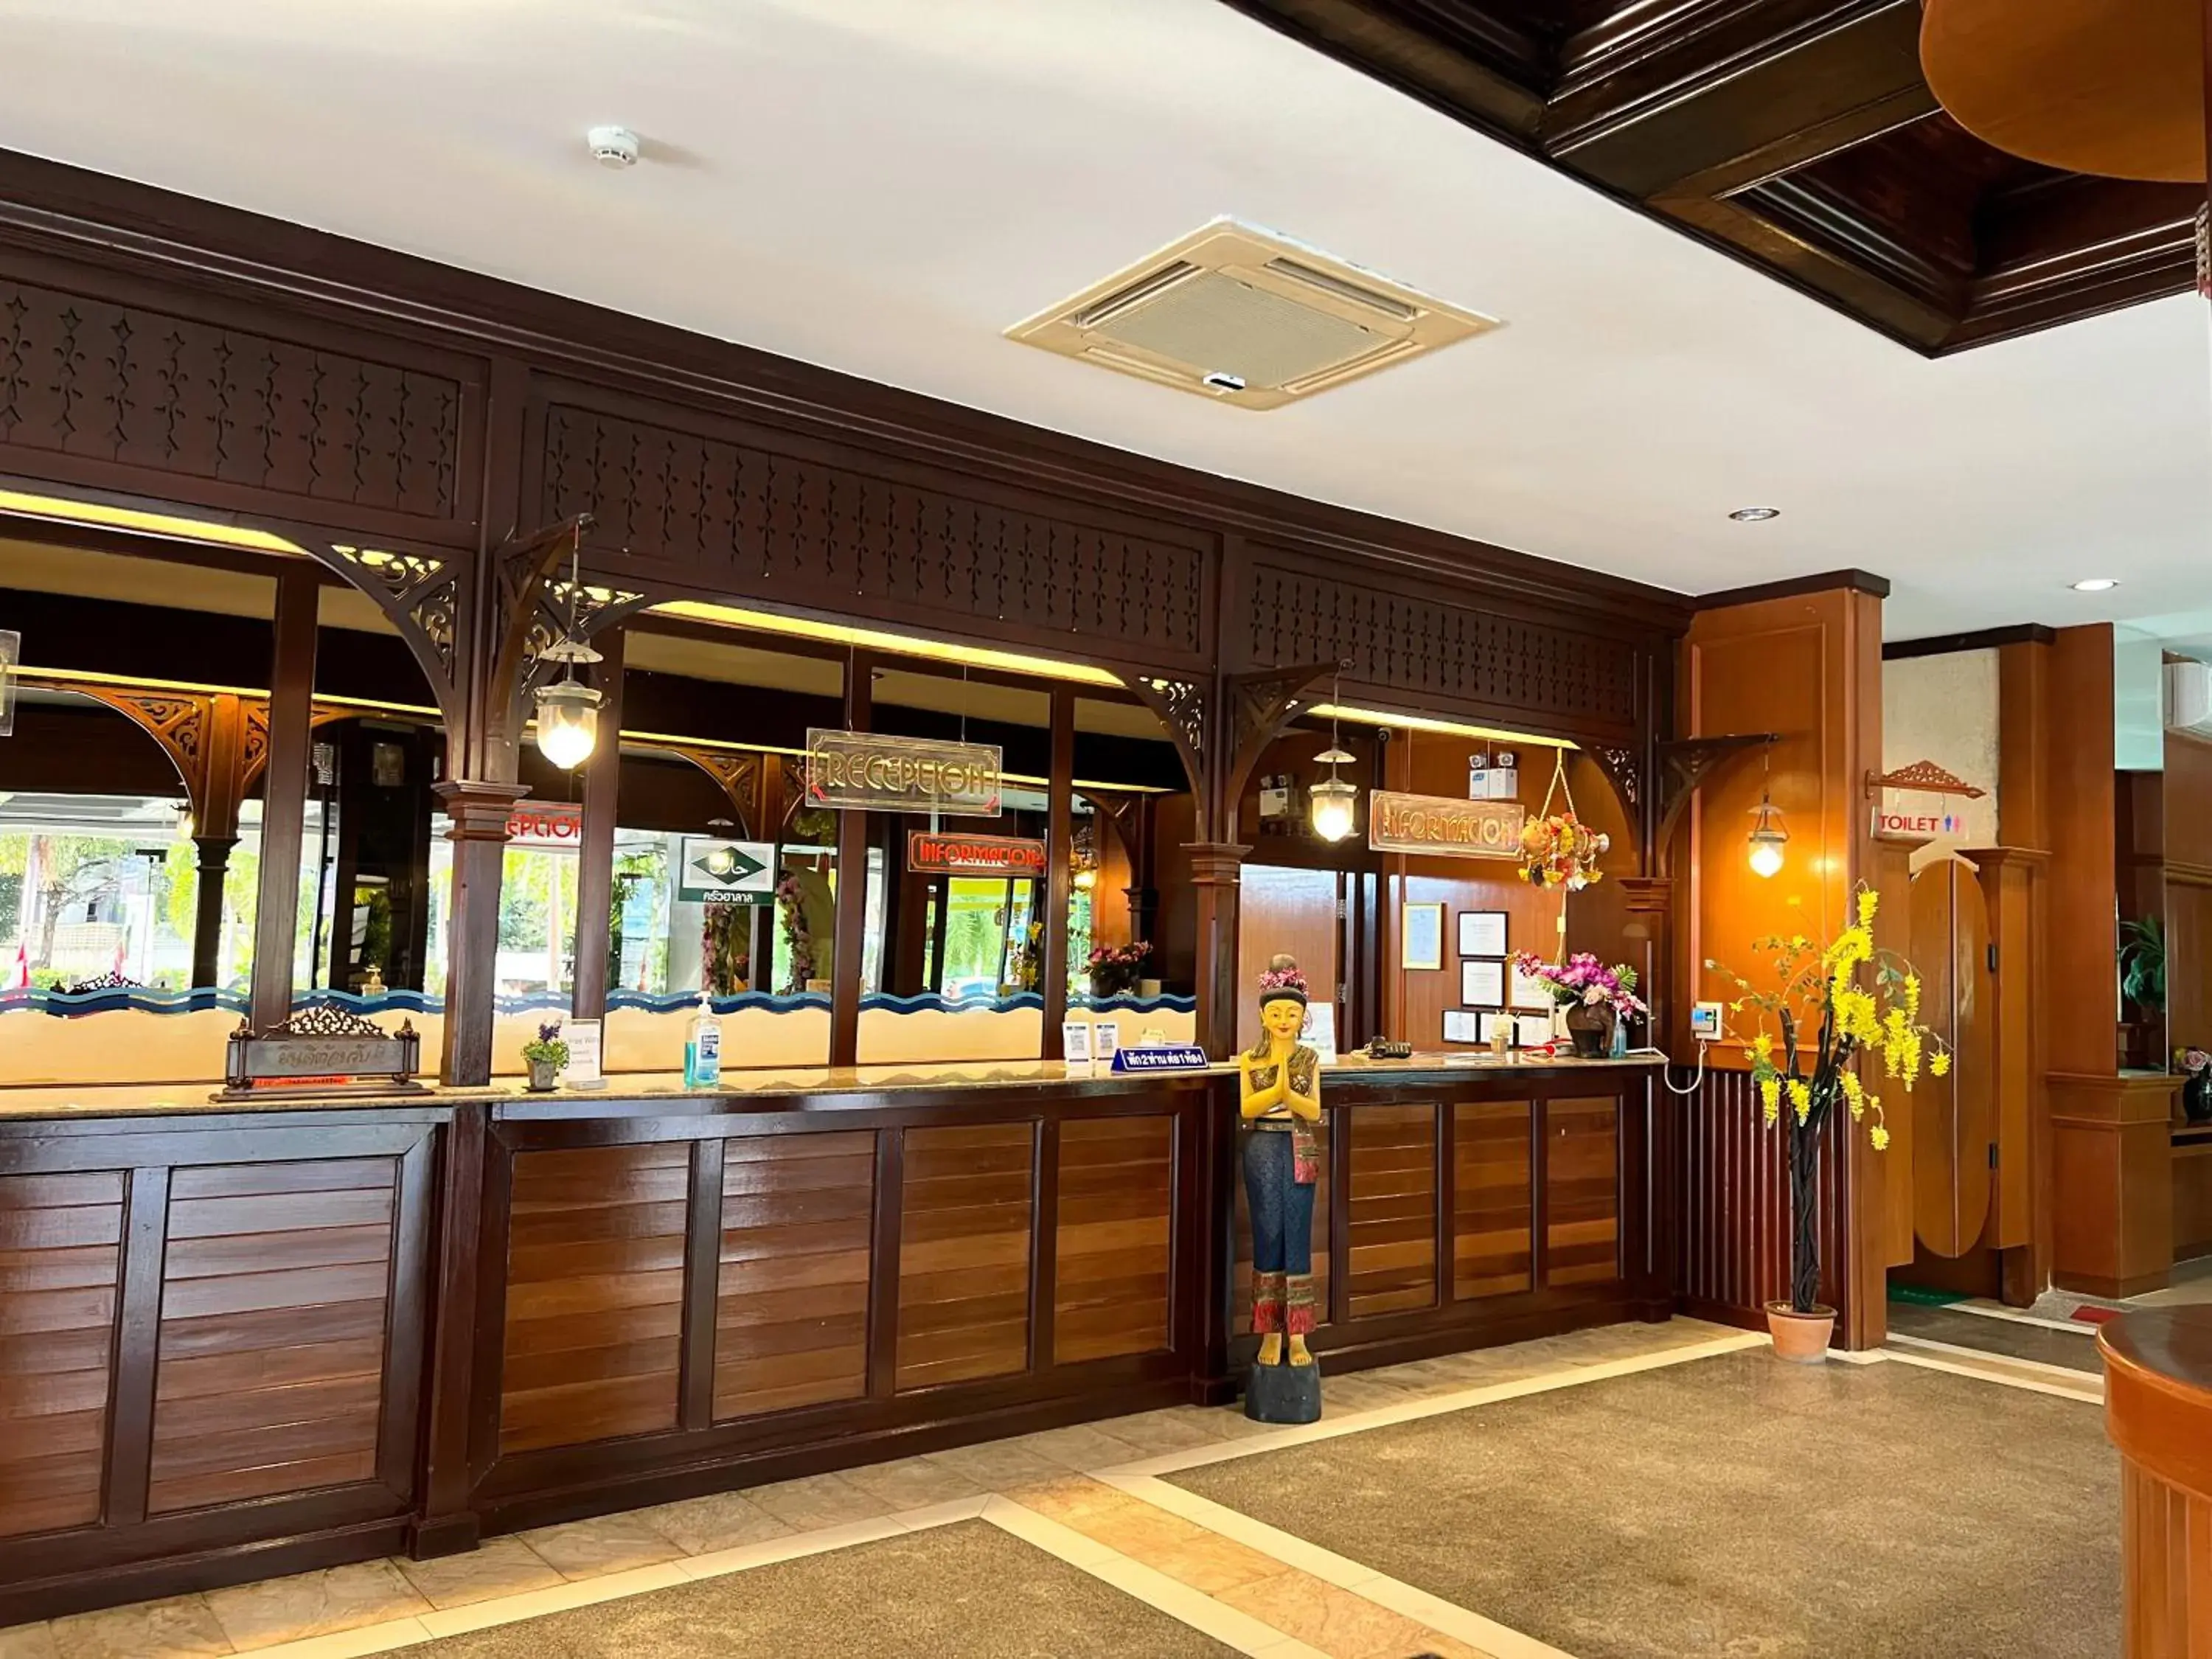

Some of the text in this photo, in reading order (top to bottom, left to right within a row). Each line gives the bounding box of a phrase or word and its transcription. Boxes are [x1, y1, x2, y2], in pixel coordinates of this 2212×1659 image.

[827, 751, 984, 794] RECEPTION
[1382, 804, 1514, 847] INFORMATION
[1879, 815, 1940, 831] TOILET
[919, 842, 1037, 866] INFORMATION
[703, 890, 753, 903] ครัวฮาลาล
